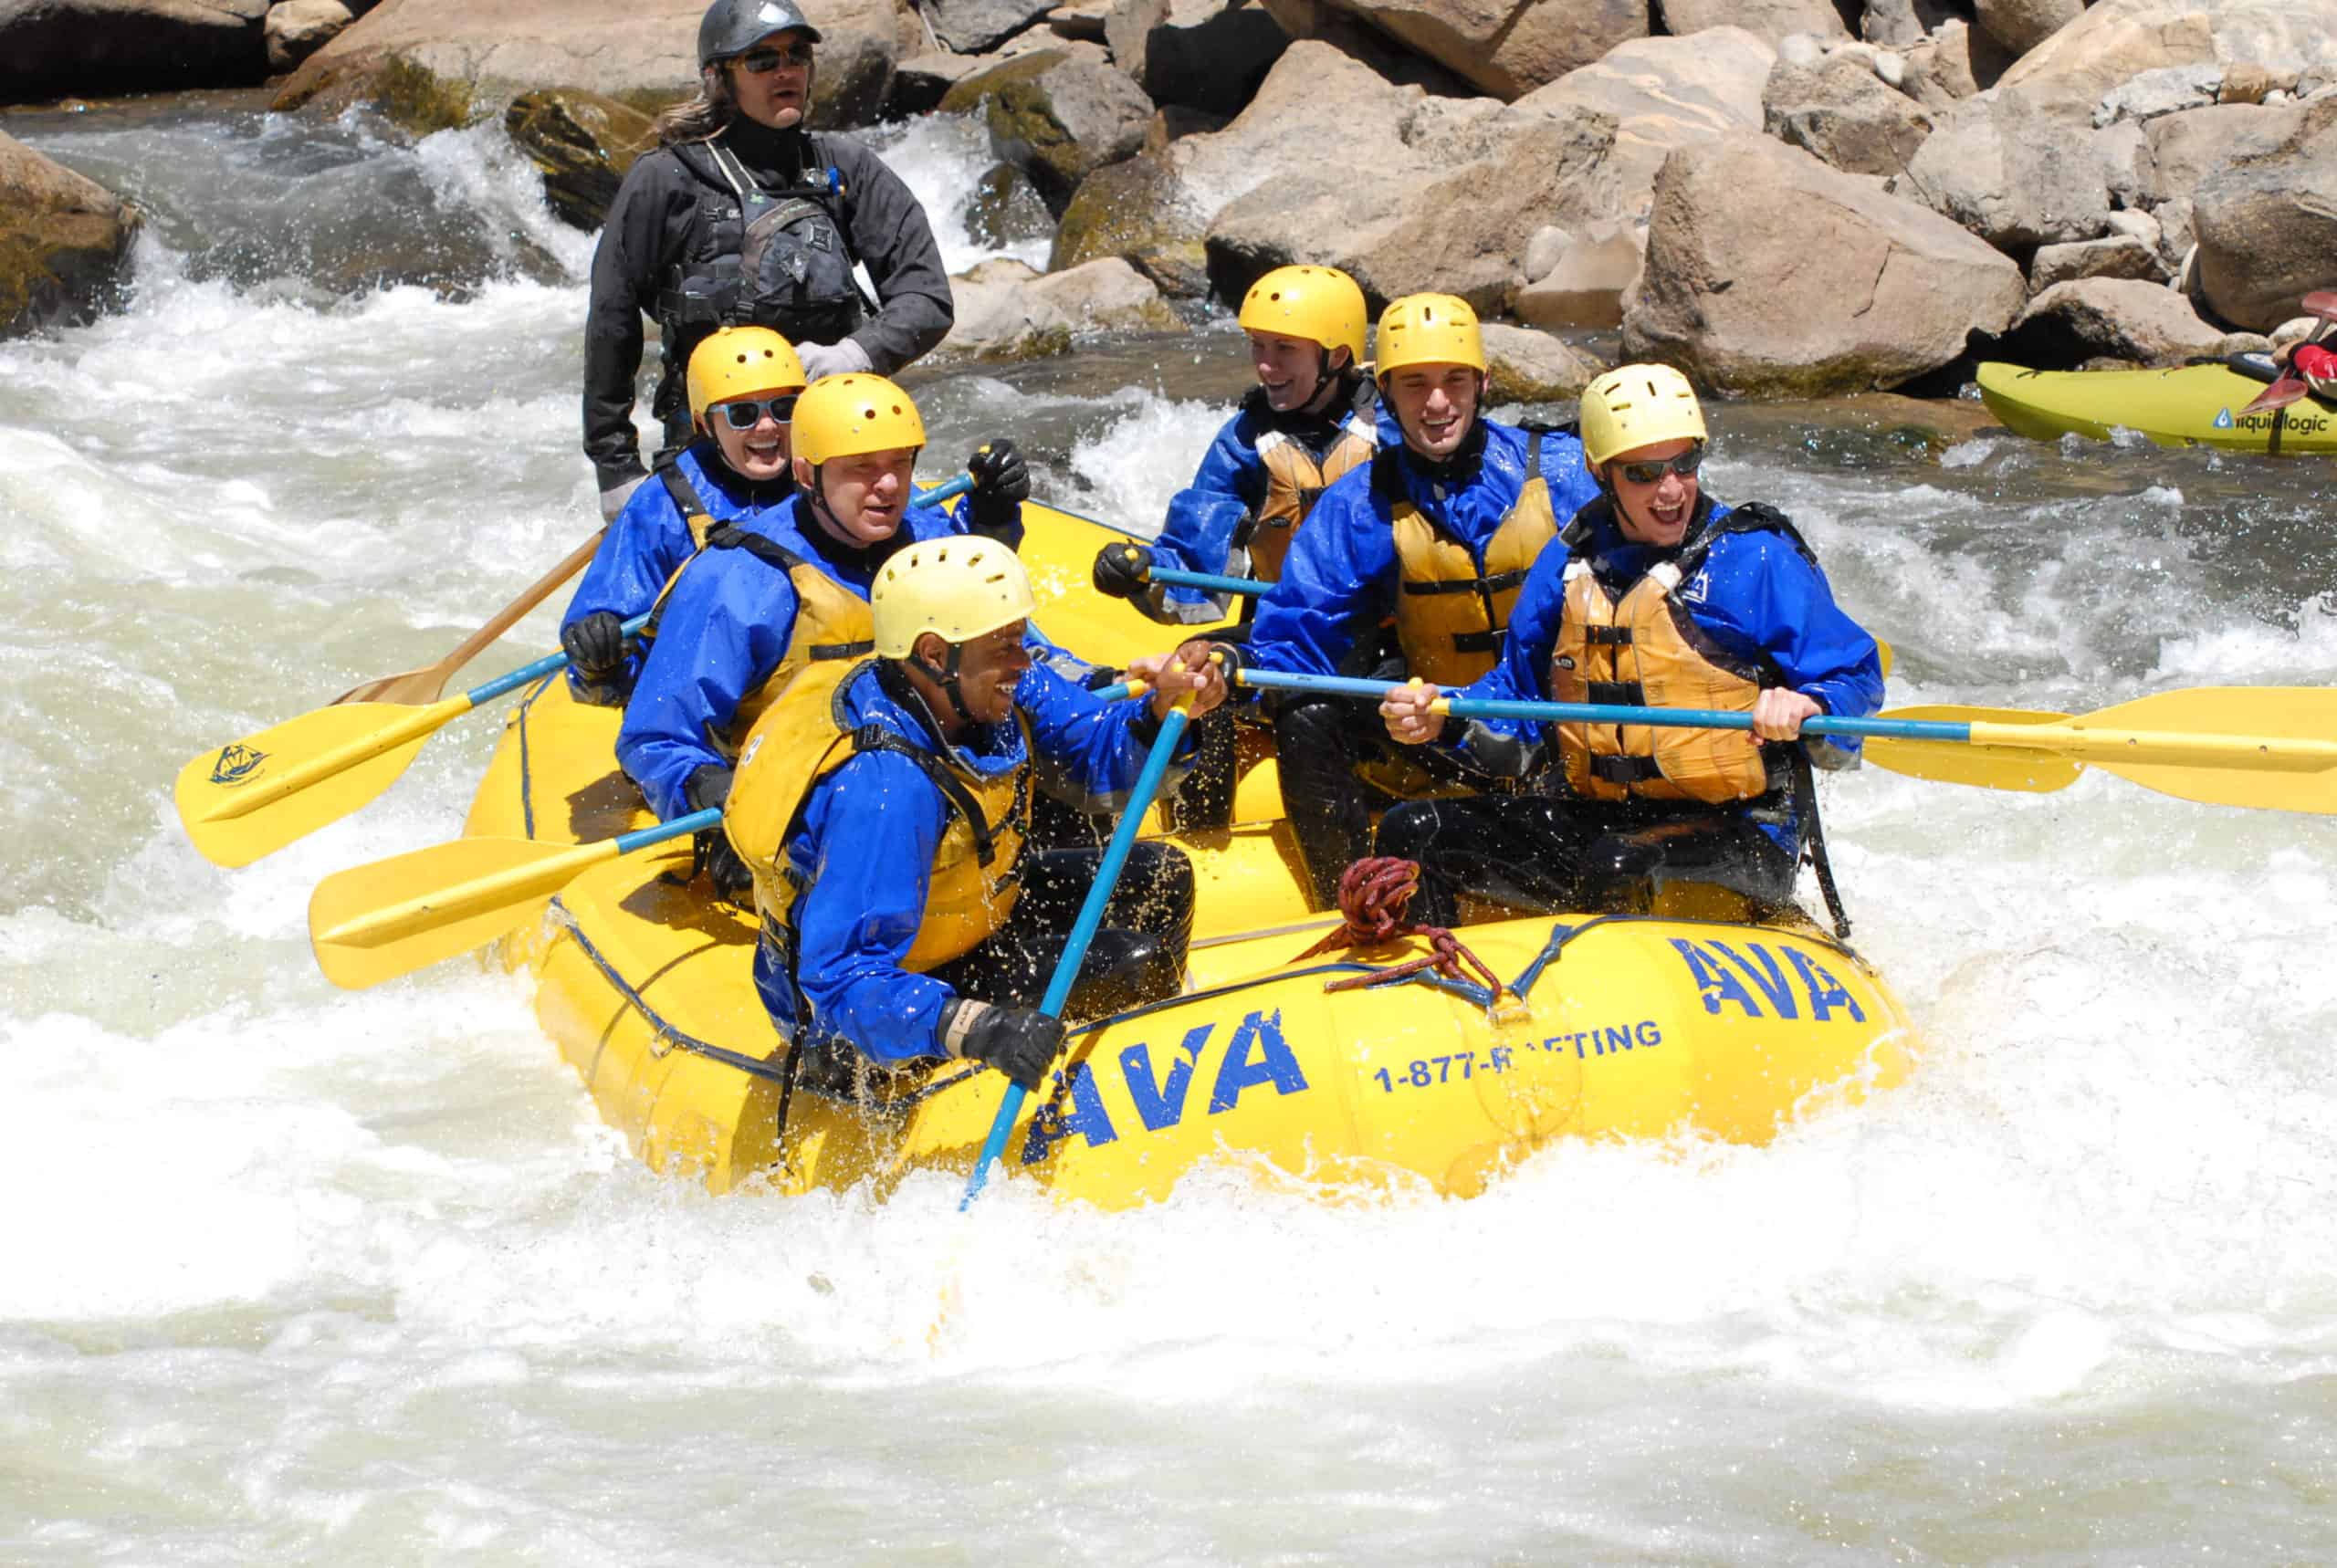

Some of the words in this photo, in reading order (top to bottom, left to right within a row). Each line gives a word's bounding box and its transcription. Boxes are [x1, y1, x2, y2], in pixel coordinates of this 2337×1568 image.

[1666, 937, 1867, 1022] AVA
[1020, 1007, 1310, 1166] AVA
[1373, 1020, 1662, 1092] 1-877-RFTING
